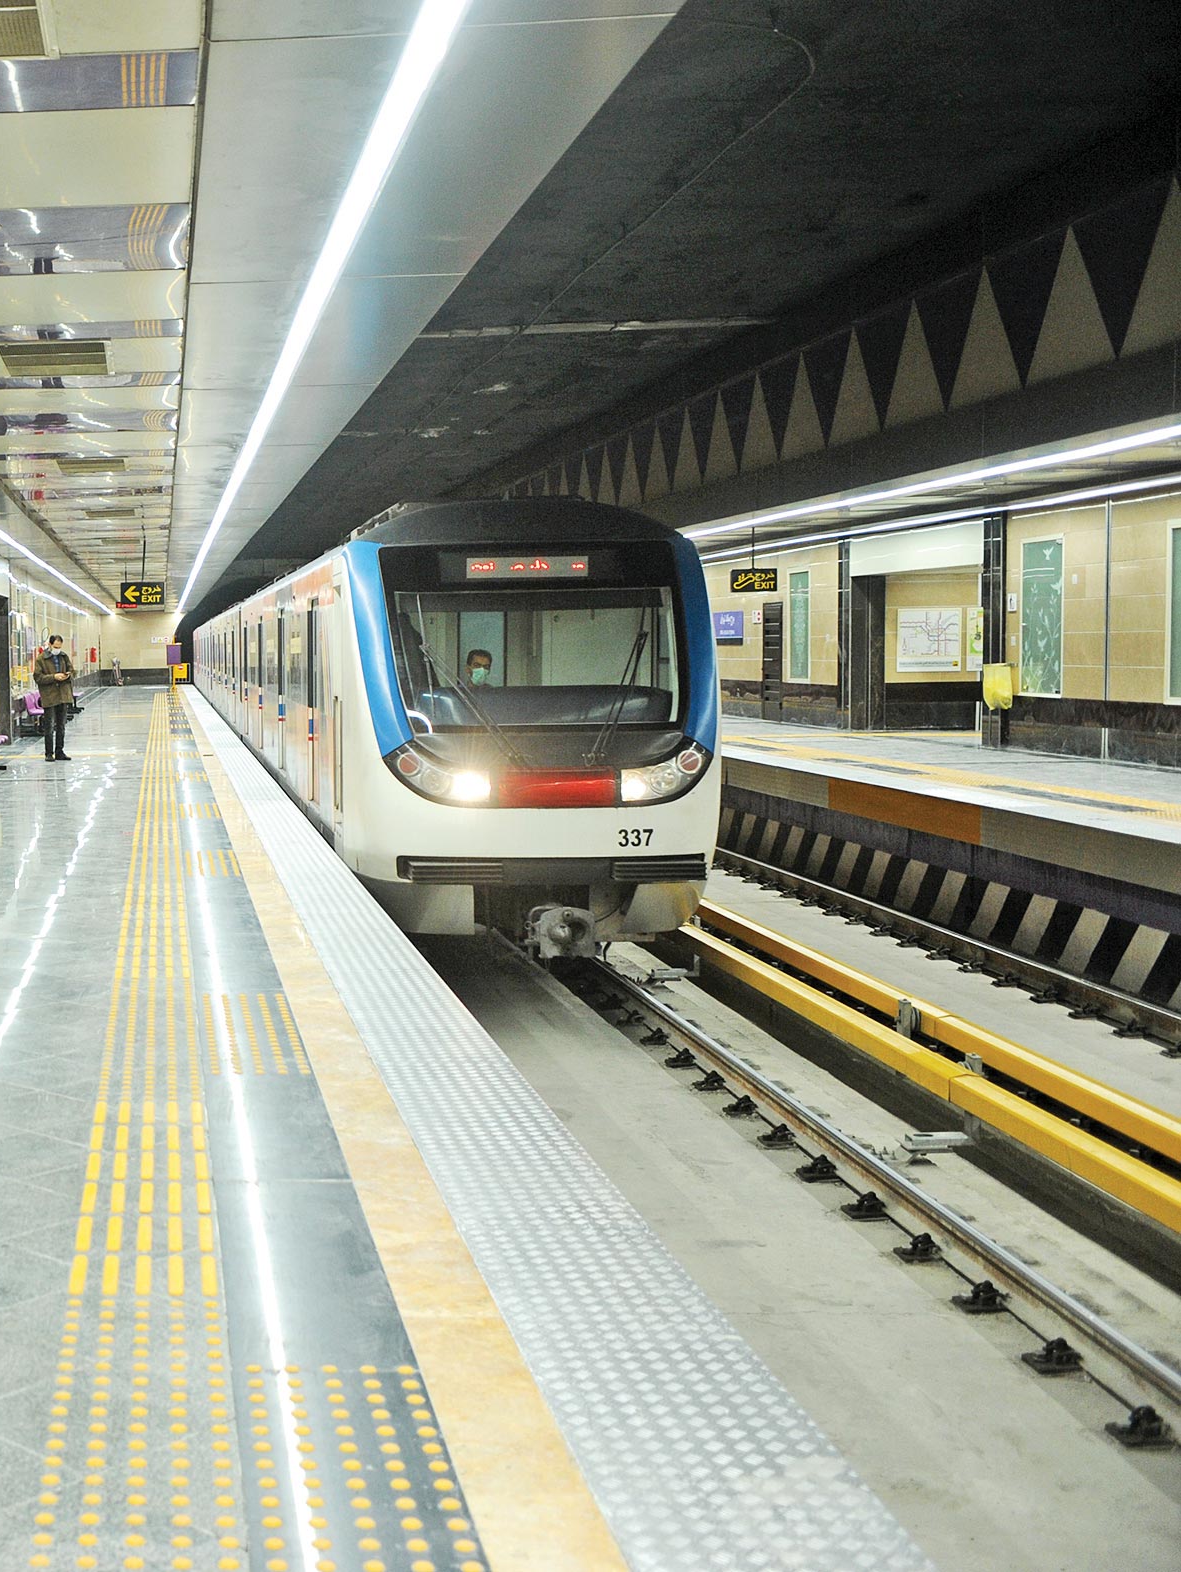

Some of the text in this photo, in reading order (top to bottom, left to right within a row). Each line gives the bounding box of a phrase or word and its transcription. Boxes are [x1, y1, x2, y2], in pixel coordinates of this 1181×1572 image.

[755, 572, 774, 581] خروج
[142, 585, 161, 594] خروج
[618, 828, 654, 848] 337
